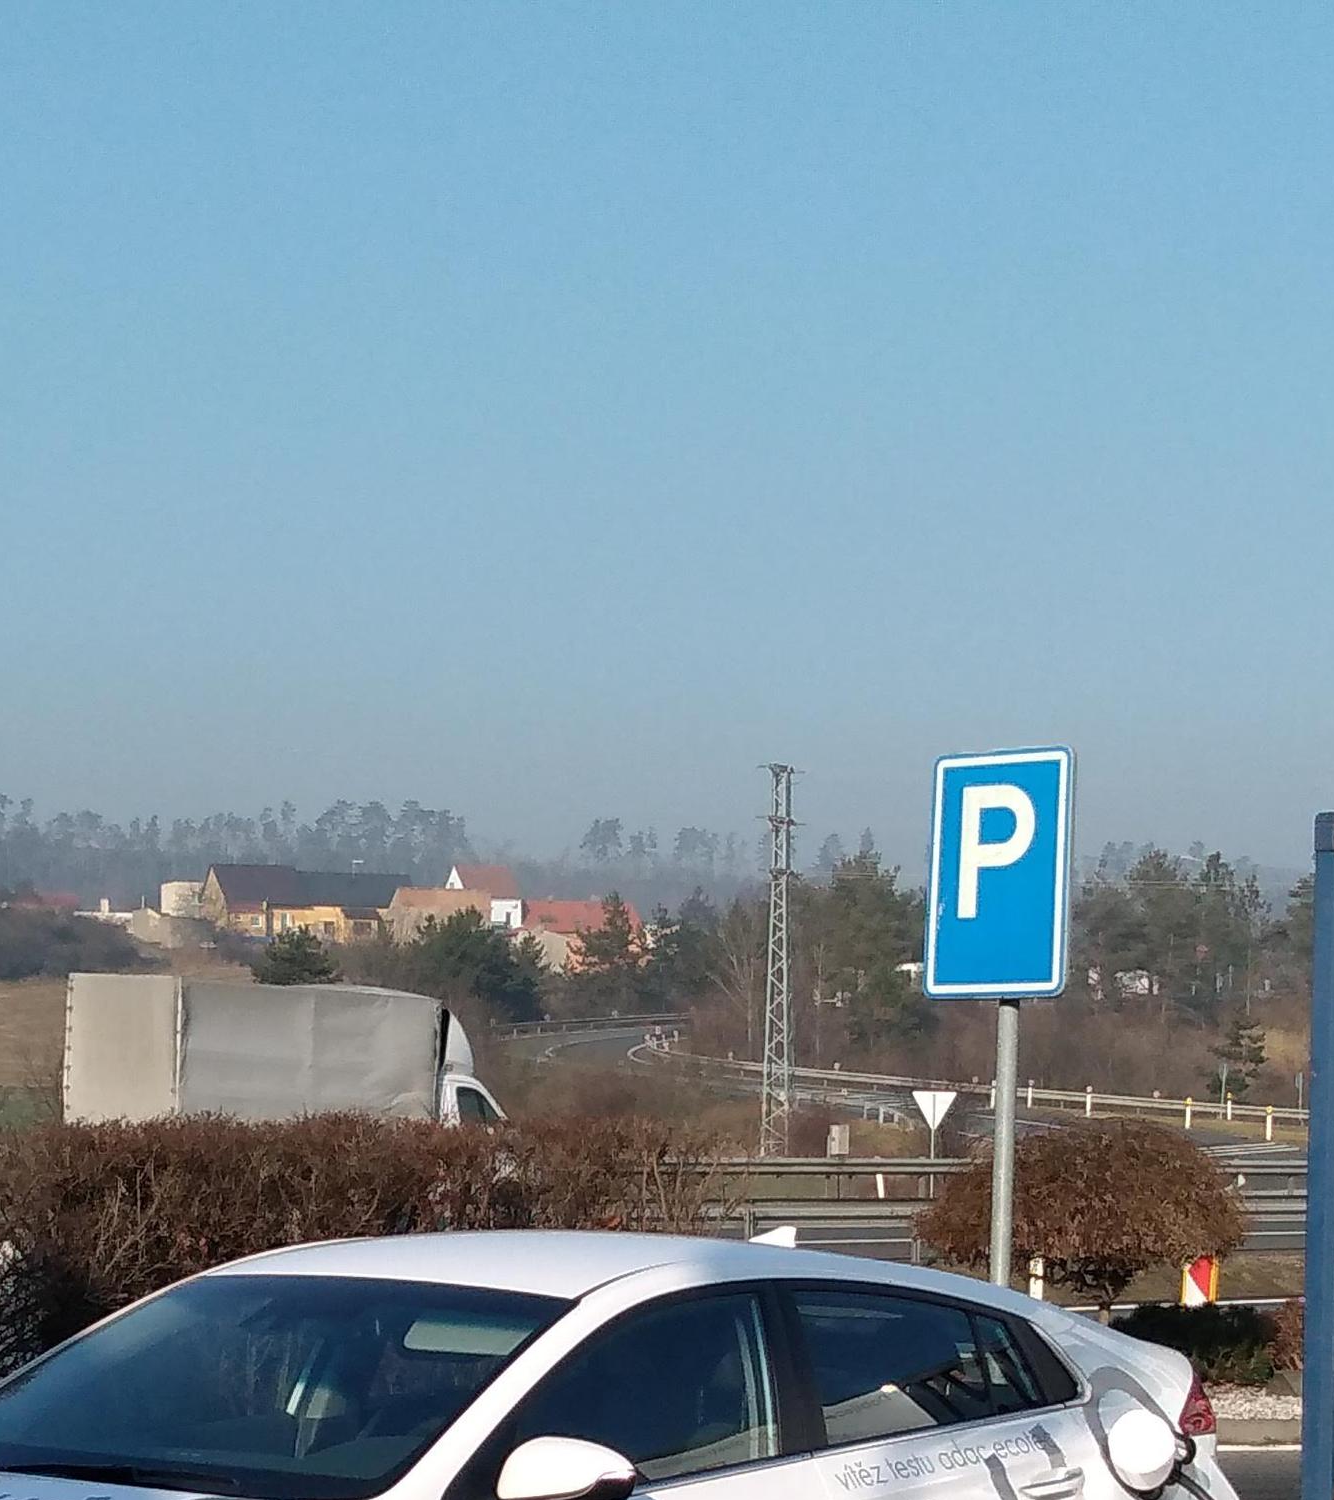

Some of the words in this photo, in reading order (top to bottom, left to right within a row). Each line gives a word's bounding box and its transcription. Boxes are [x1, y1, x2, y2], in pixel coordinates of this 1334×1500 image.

[957, 784, 1036, 919] P
[834, 1460, 889, 1492] vítěz
[885, 1454, 936, 1482] testu
[938, 1438, 989, 1472] adac
